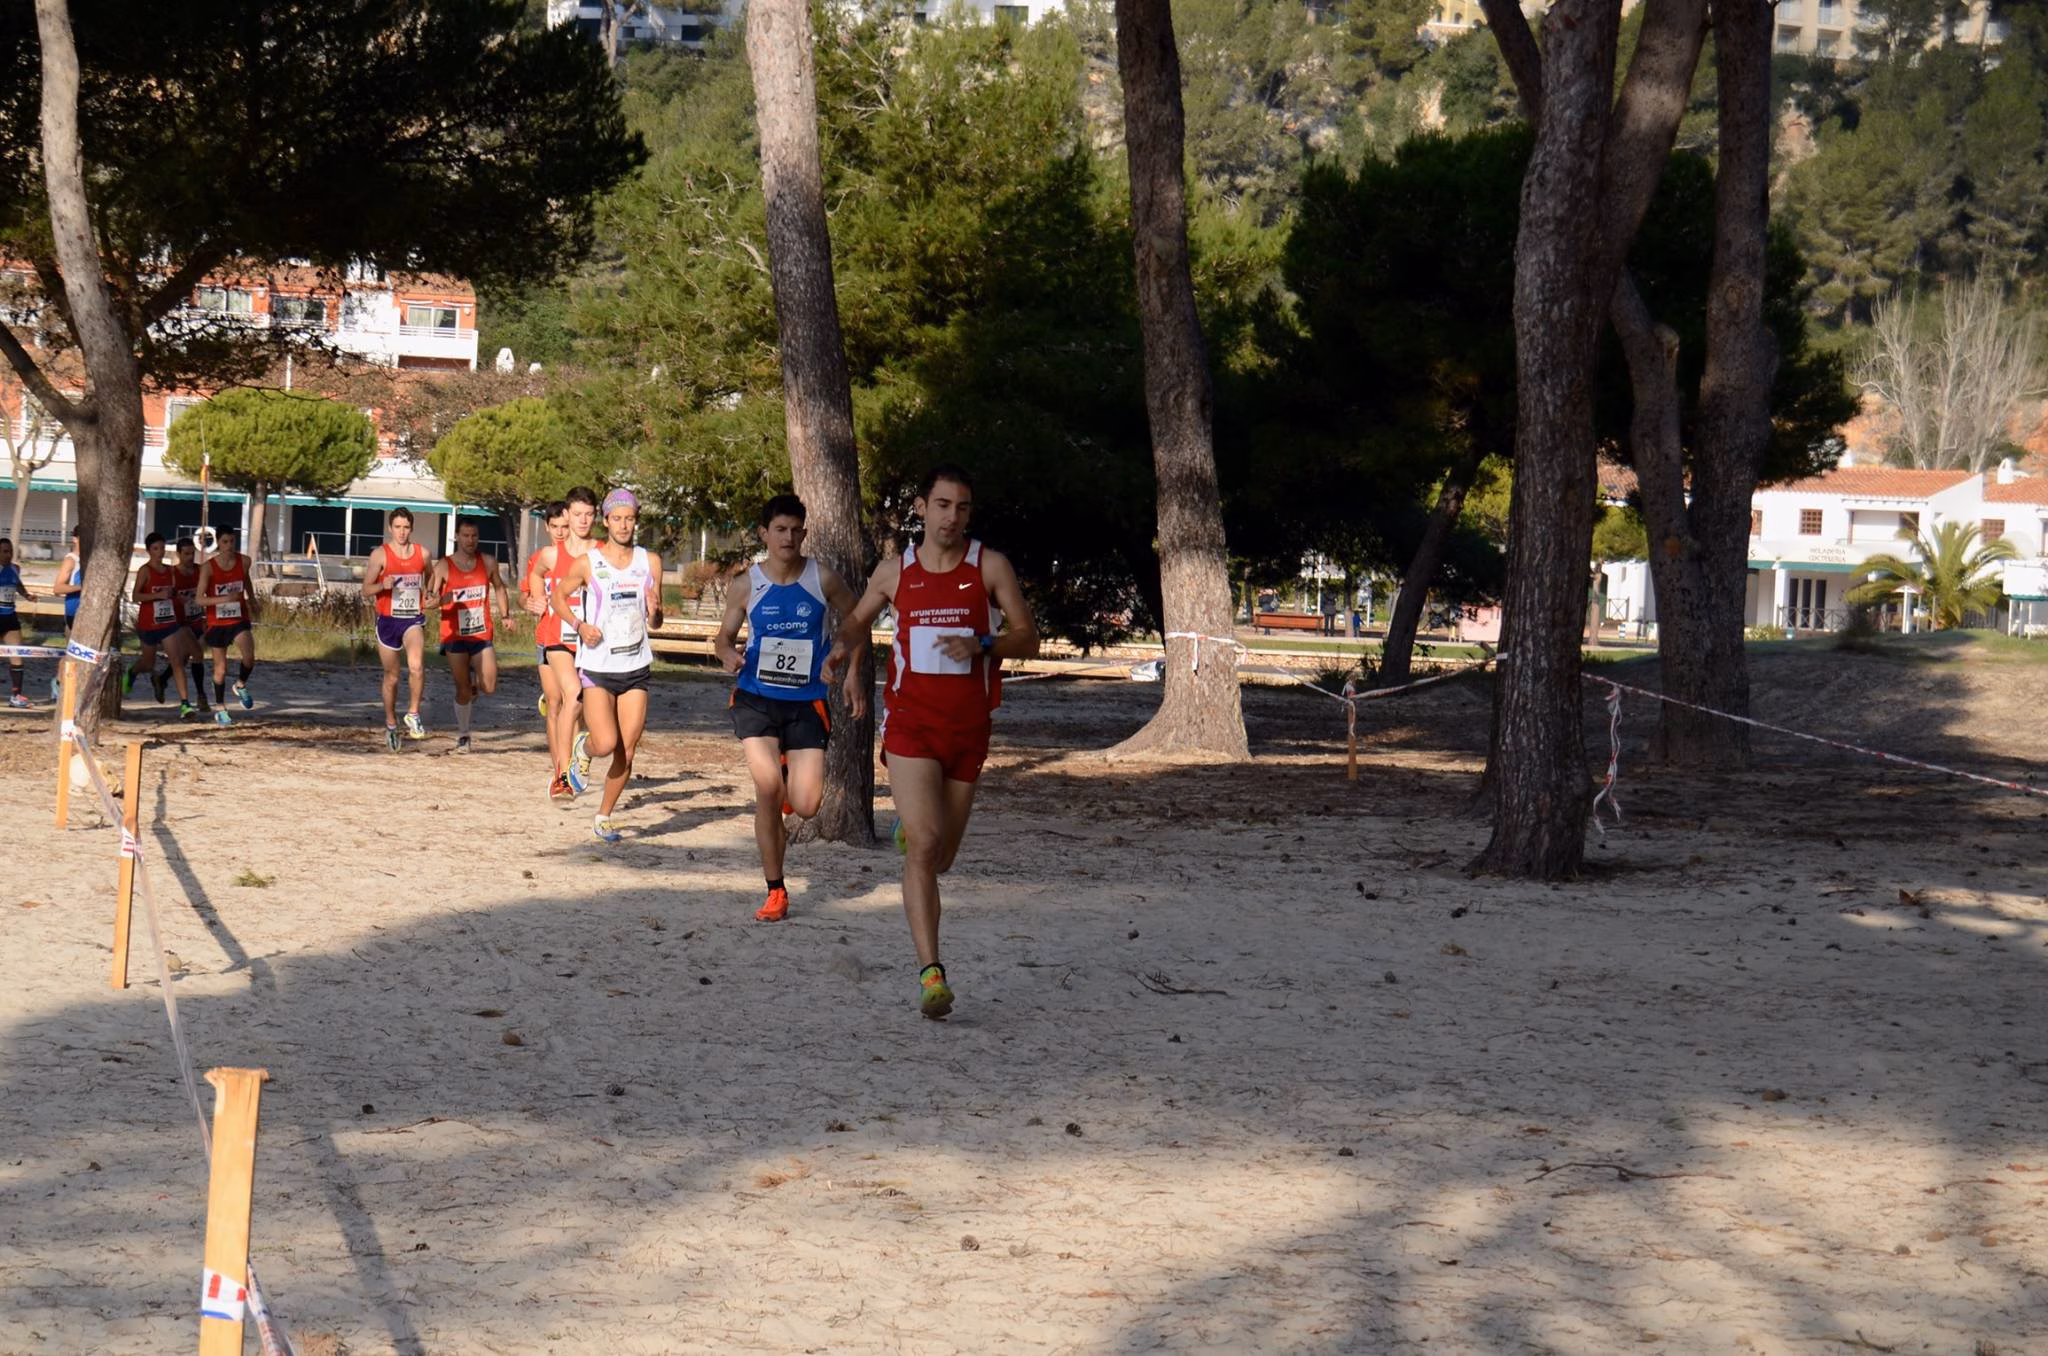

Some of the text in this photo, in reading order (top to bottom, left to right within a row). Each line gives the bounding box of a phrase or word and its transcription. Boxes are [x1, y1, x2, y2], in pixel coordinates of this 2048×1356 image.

[398, 598, 416, 608] 202
[909, 608, 970, 618] AYUNTAMIENTO
[775, 654, 797, 671] 82
